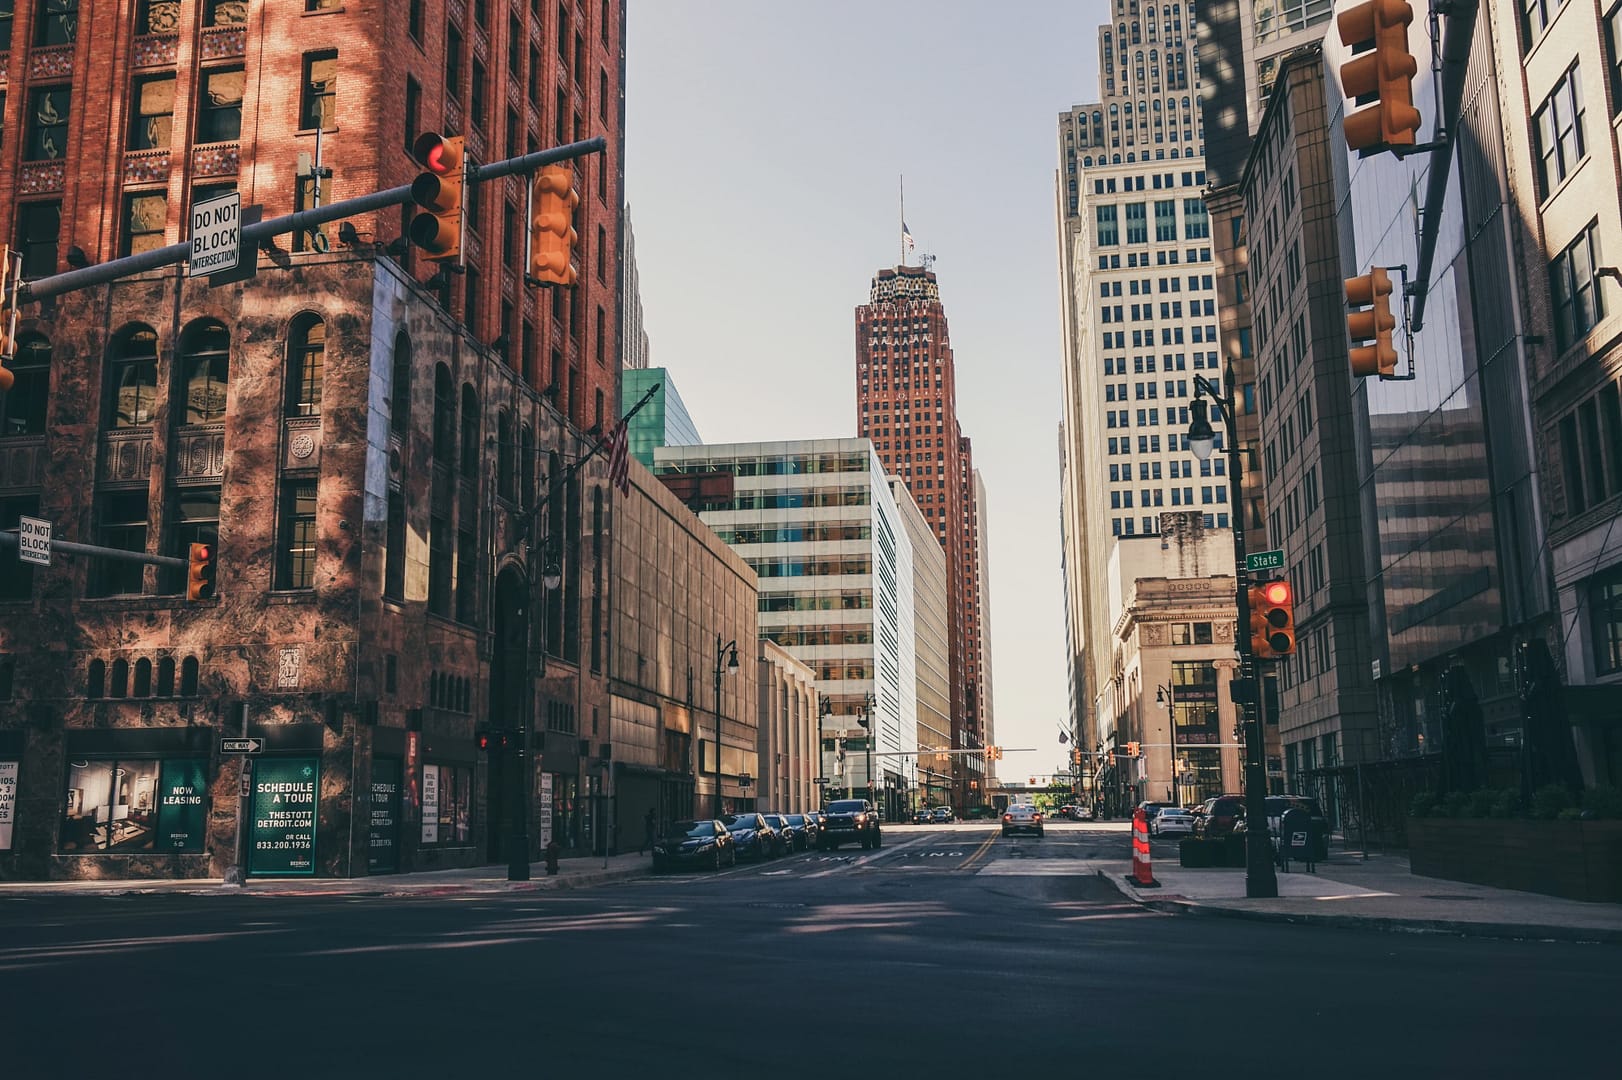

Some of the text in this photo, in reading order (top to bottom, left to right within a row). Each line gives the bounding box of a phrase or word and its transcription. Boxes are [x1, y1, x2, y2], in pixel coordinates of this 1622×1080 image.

[195, 203, 238, 230] DO NOT
[194, 227, 237, 254] BLOCK
[191, 248, 236, 270] INTERSECTION
[22, 522, 50, 537] DO NOT
[21, 537, 49, 551] BLOCK
[1253, 555, 1278, 567] State
[173, 786, 193, 795] NOW
[257, 783, 313, 793] SCHEDULE
[371, 783, 396, 793] SCHEDULE
[163, 796, 201, 805] LEASING
[273, 793, 313, 803] A TOUR
[375, 793, 389, 803] TOUR
[269, 811, 312, 819] THESTOTT
[257, 819, 312, 828] DETROIT.COM
[371, 818, 393, 826] ETROIT.COM
[256, 841, 311, 849] 833.200.1936
